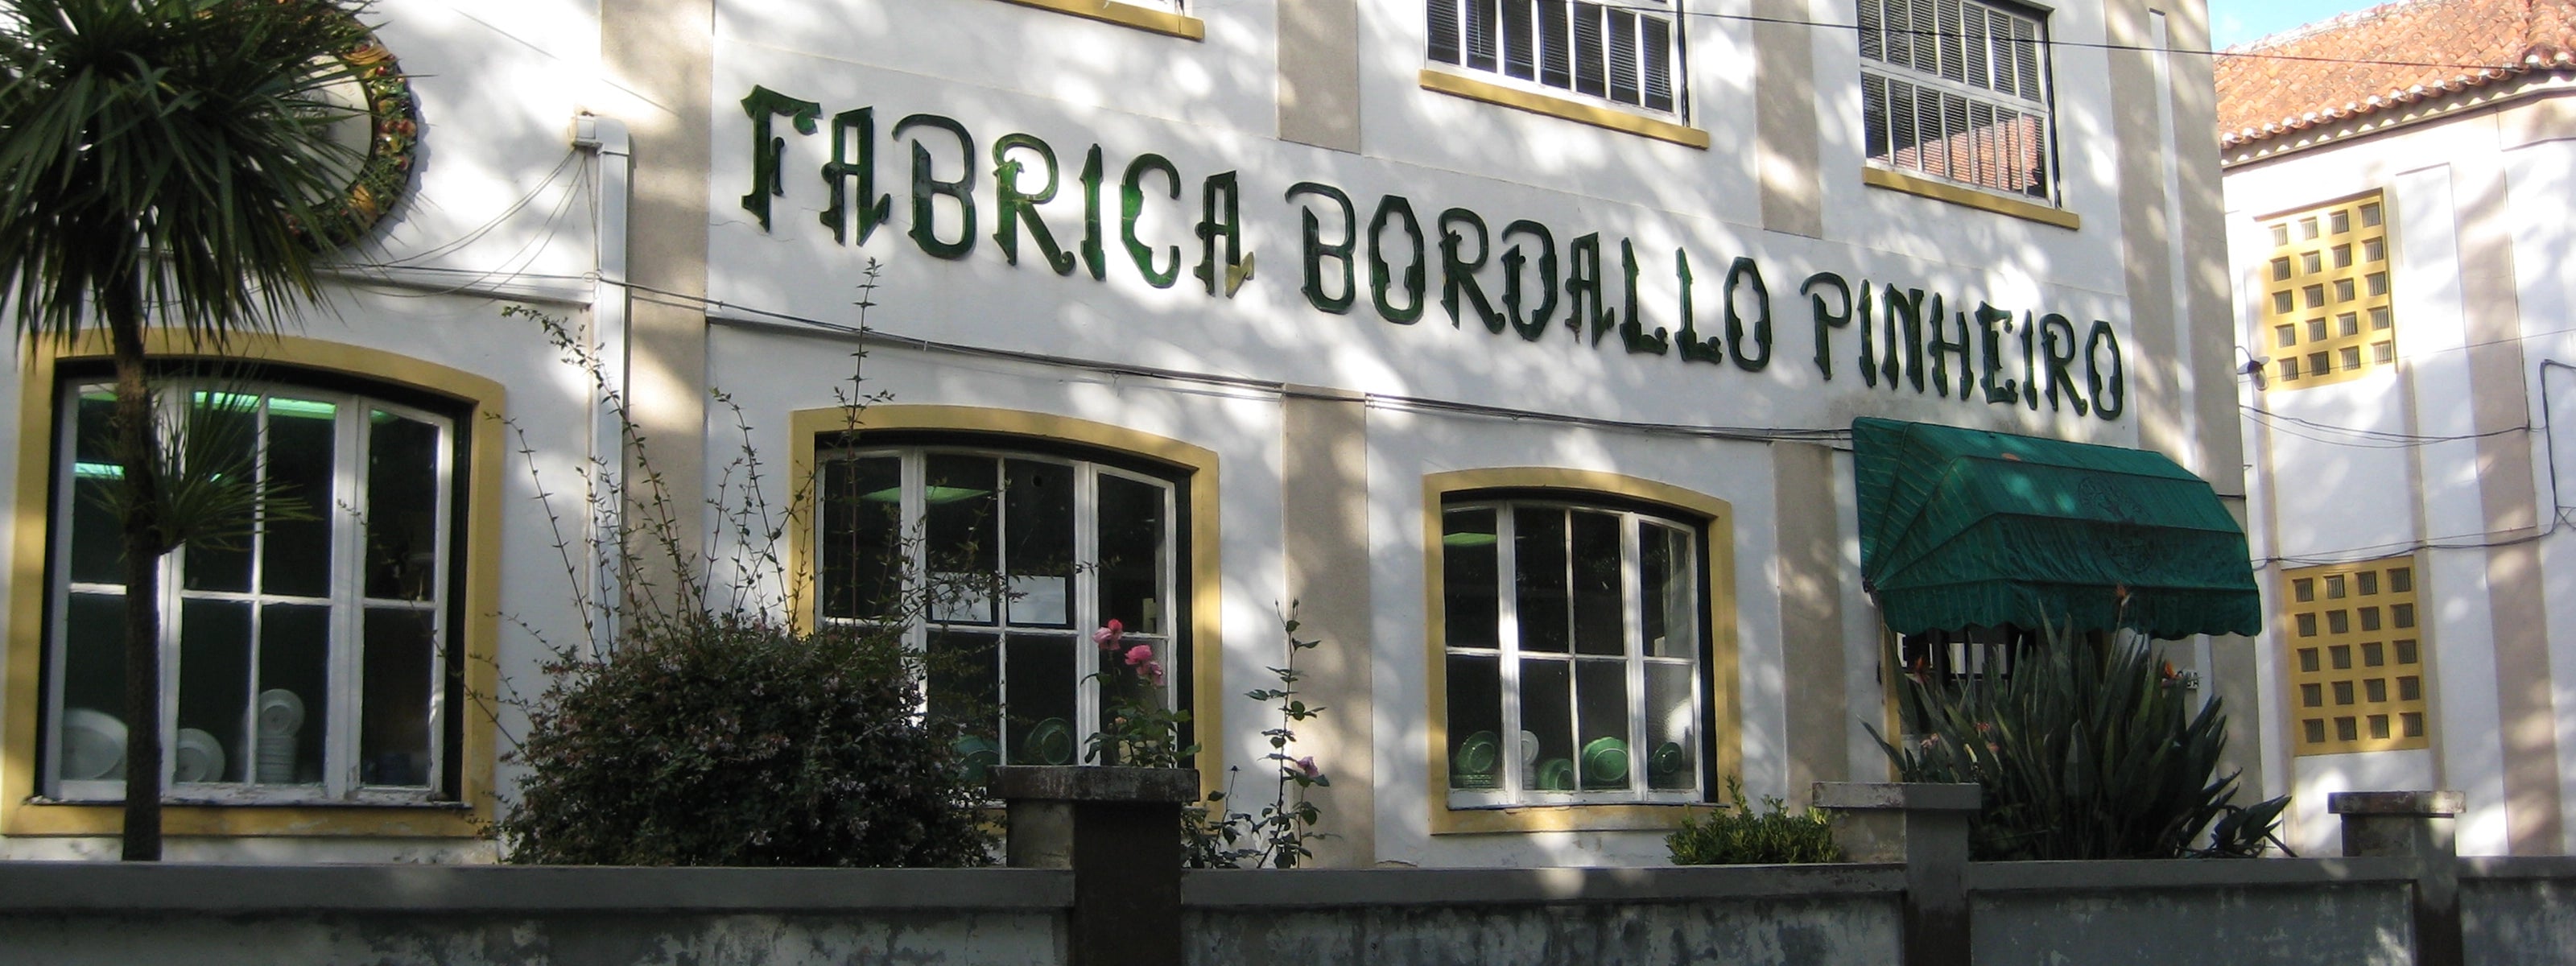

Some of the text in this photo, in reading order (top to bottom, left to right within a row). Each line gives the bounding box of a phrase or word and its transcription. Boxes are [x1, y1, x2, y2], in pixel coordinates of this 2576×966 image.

[741, 84, 2123, 420] FABRICA BORDALLO PINHEIRO
